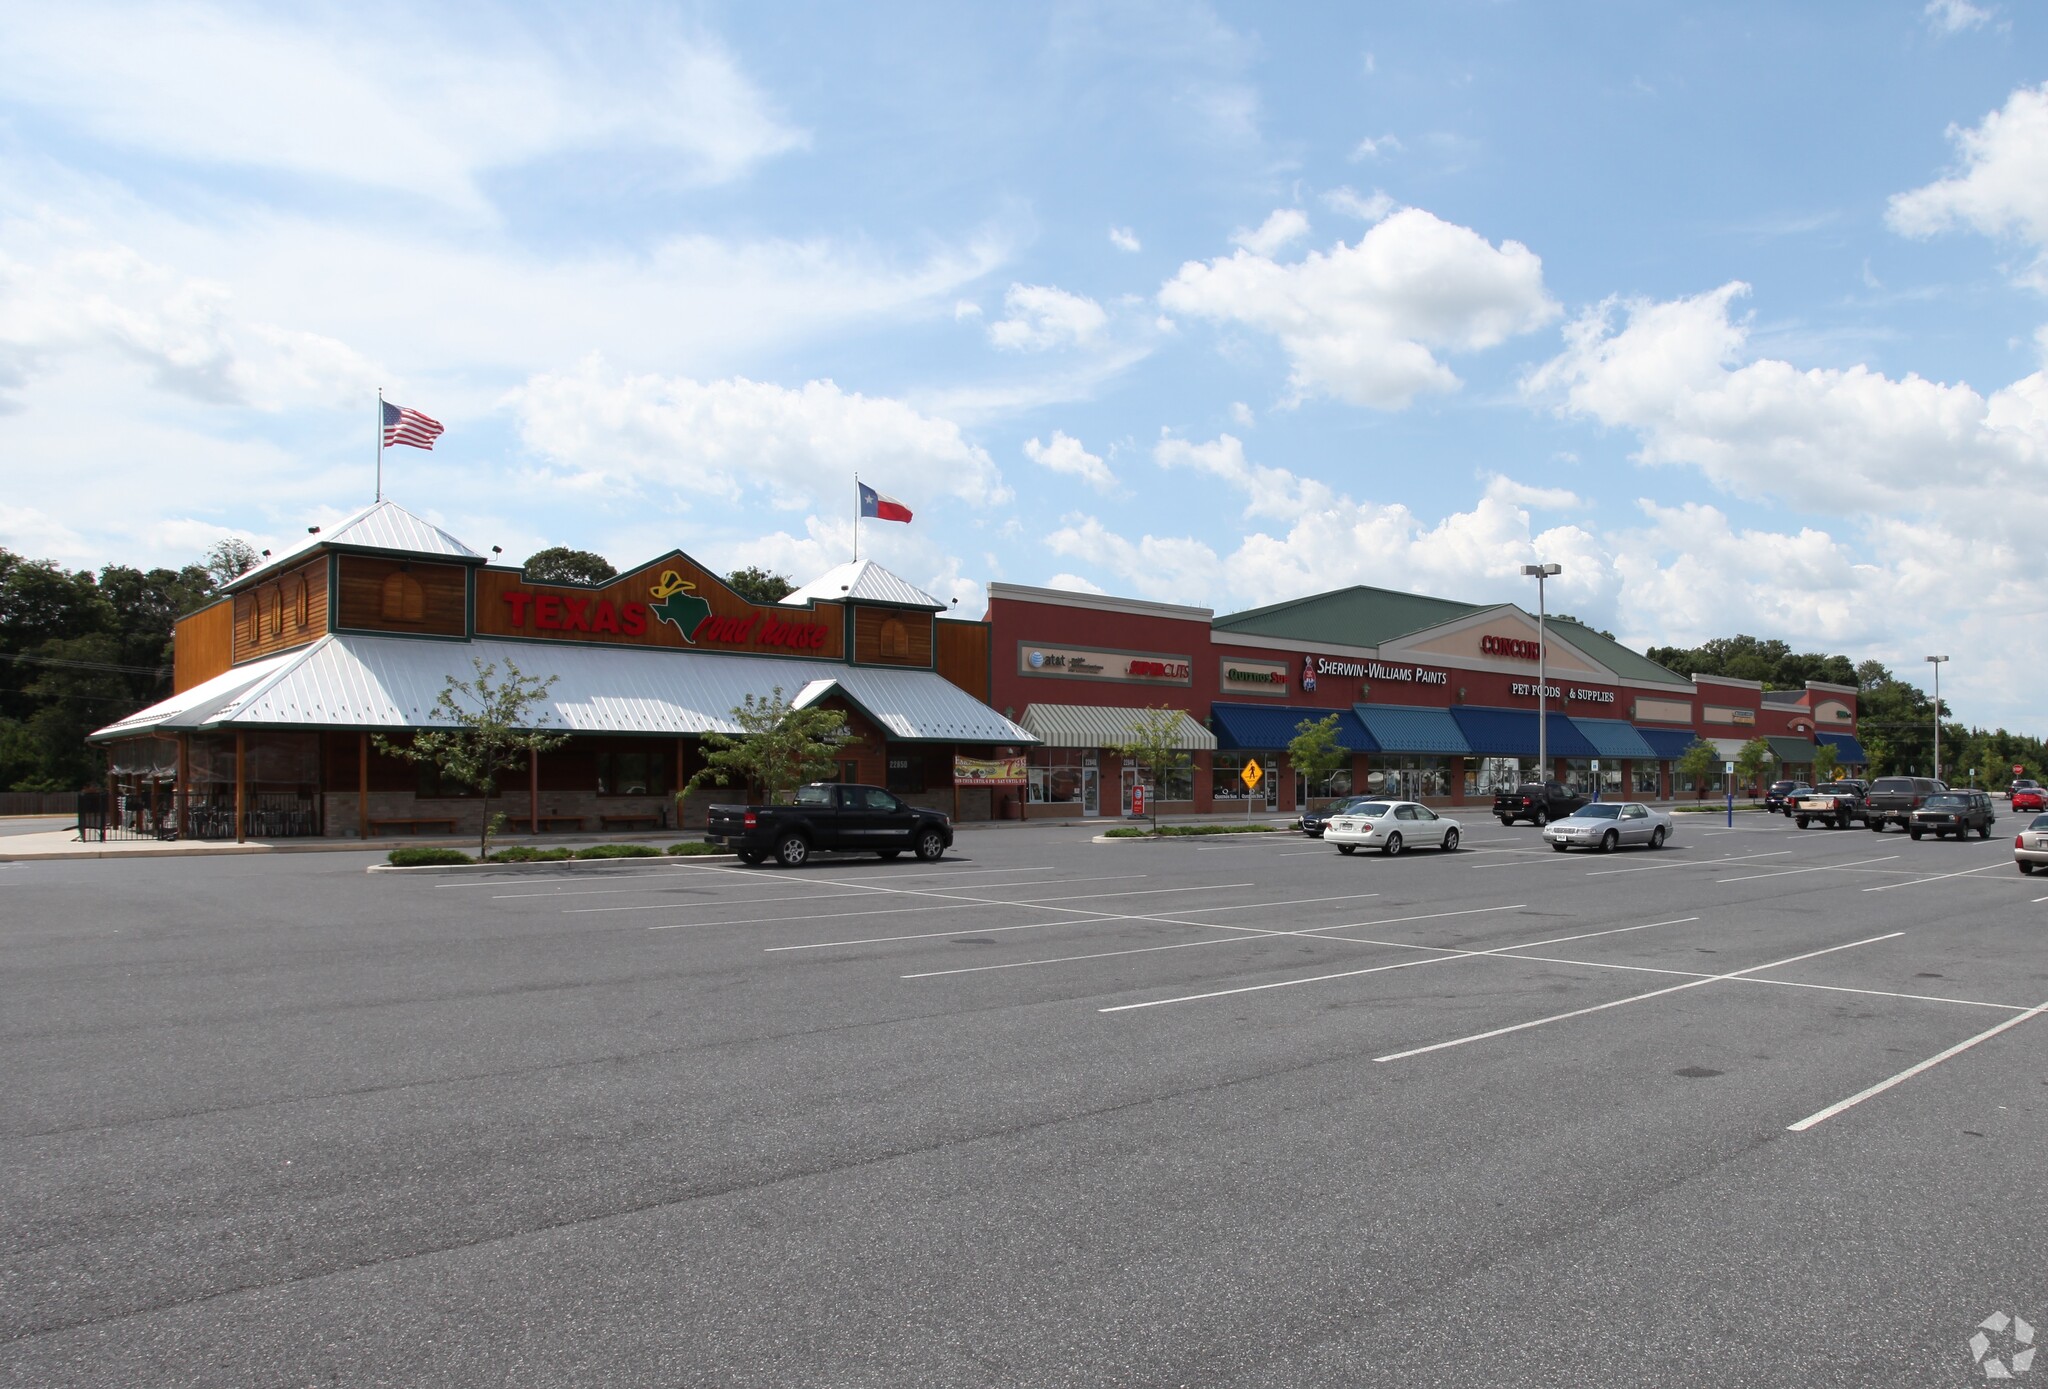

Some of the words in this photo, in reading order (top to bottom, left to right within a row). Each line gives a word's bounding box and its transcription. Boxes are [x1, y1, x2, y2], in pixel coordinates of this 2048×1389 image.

[503, 591, 649, 636] TEXAS
[1415, 667, 1447, 685] PAINTS
[1511, 683, 1530, 695] PET
[1577, 689, 1615, 702] SUPPLIES
